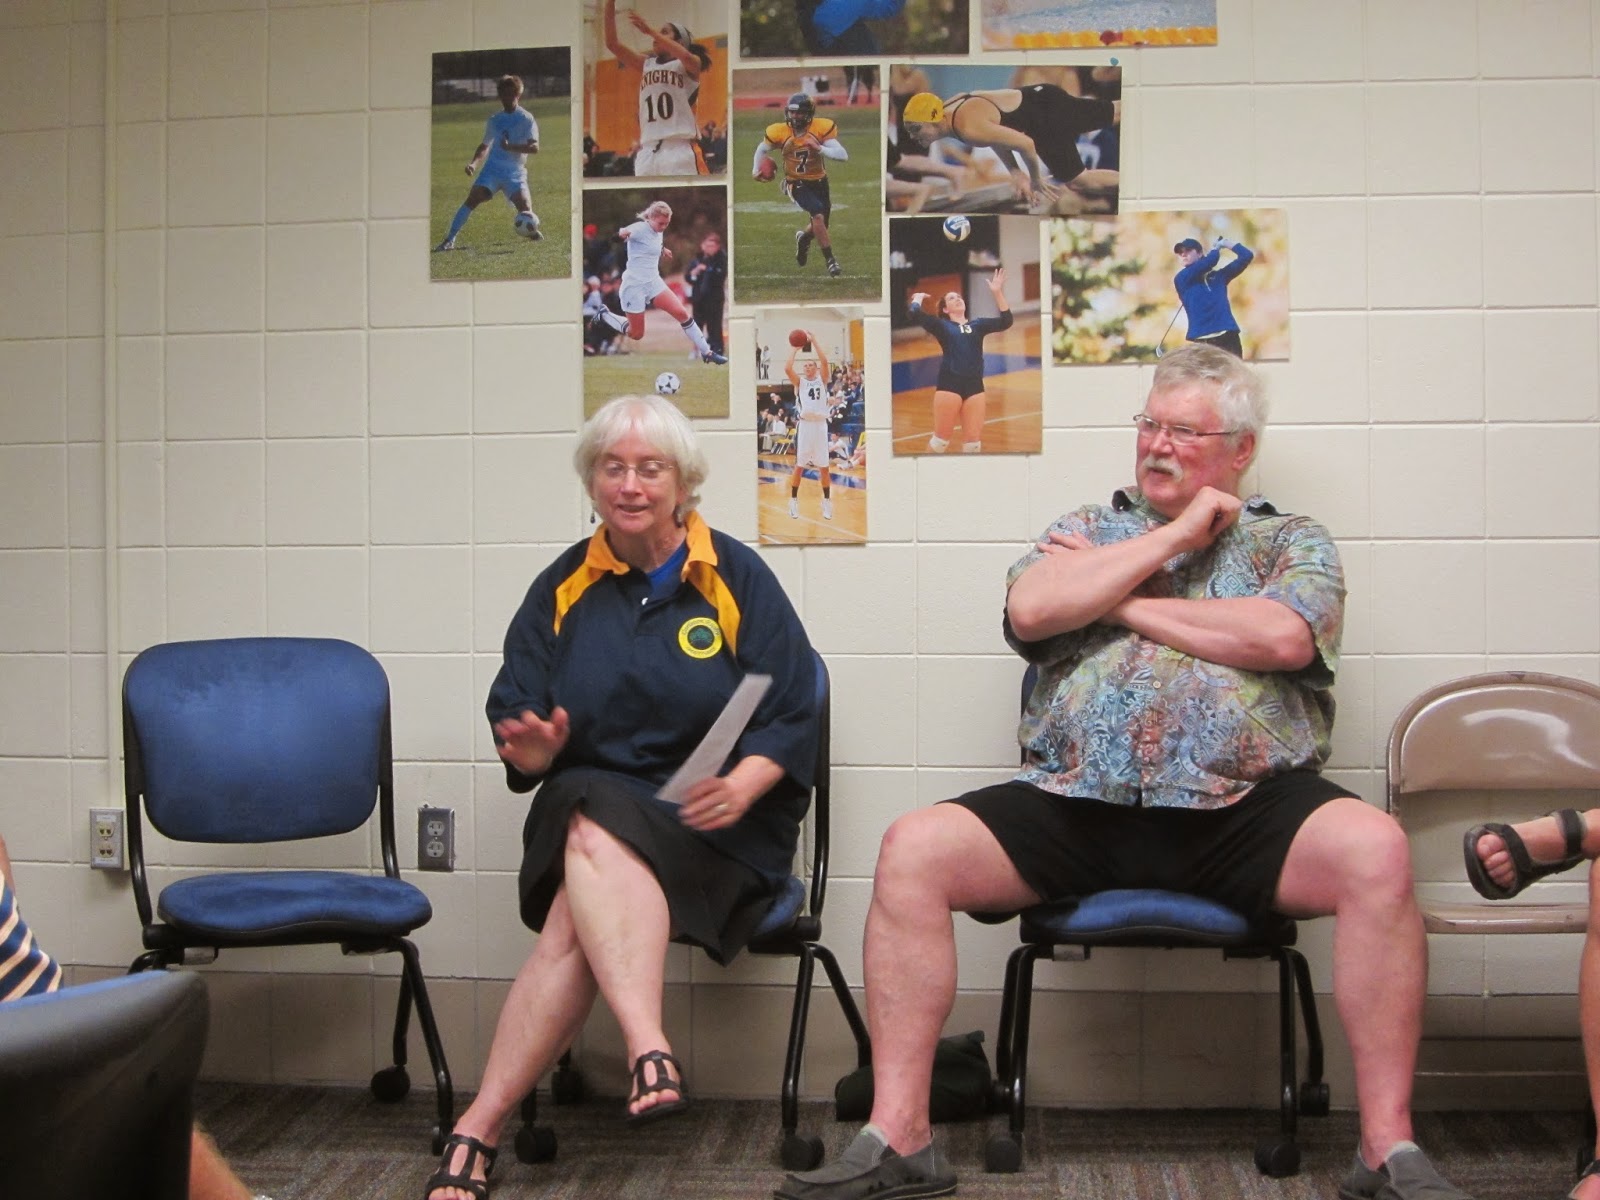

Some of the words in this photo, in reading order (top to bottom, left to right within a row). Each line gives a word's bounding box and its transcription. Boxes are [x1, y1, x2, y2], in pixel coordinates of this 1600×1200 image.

[641, 69, 684, 91] NIGHTS
[645, 92, 674, 123] 10
[794, 150, 809, 173] 7
